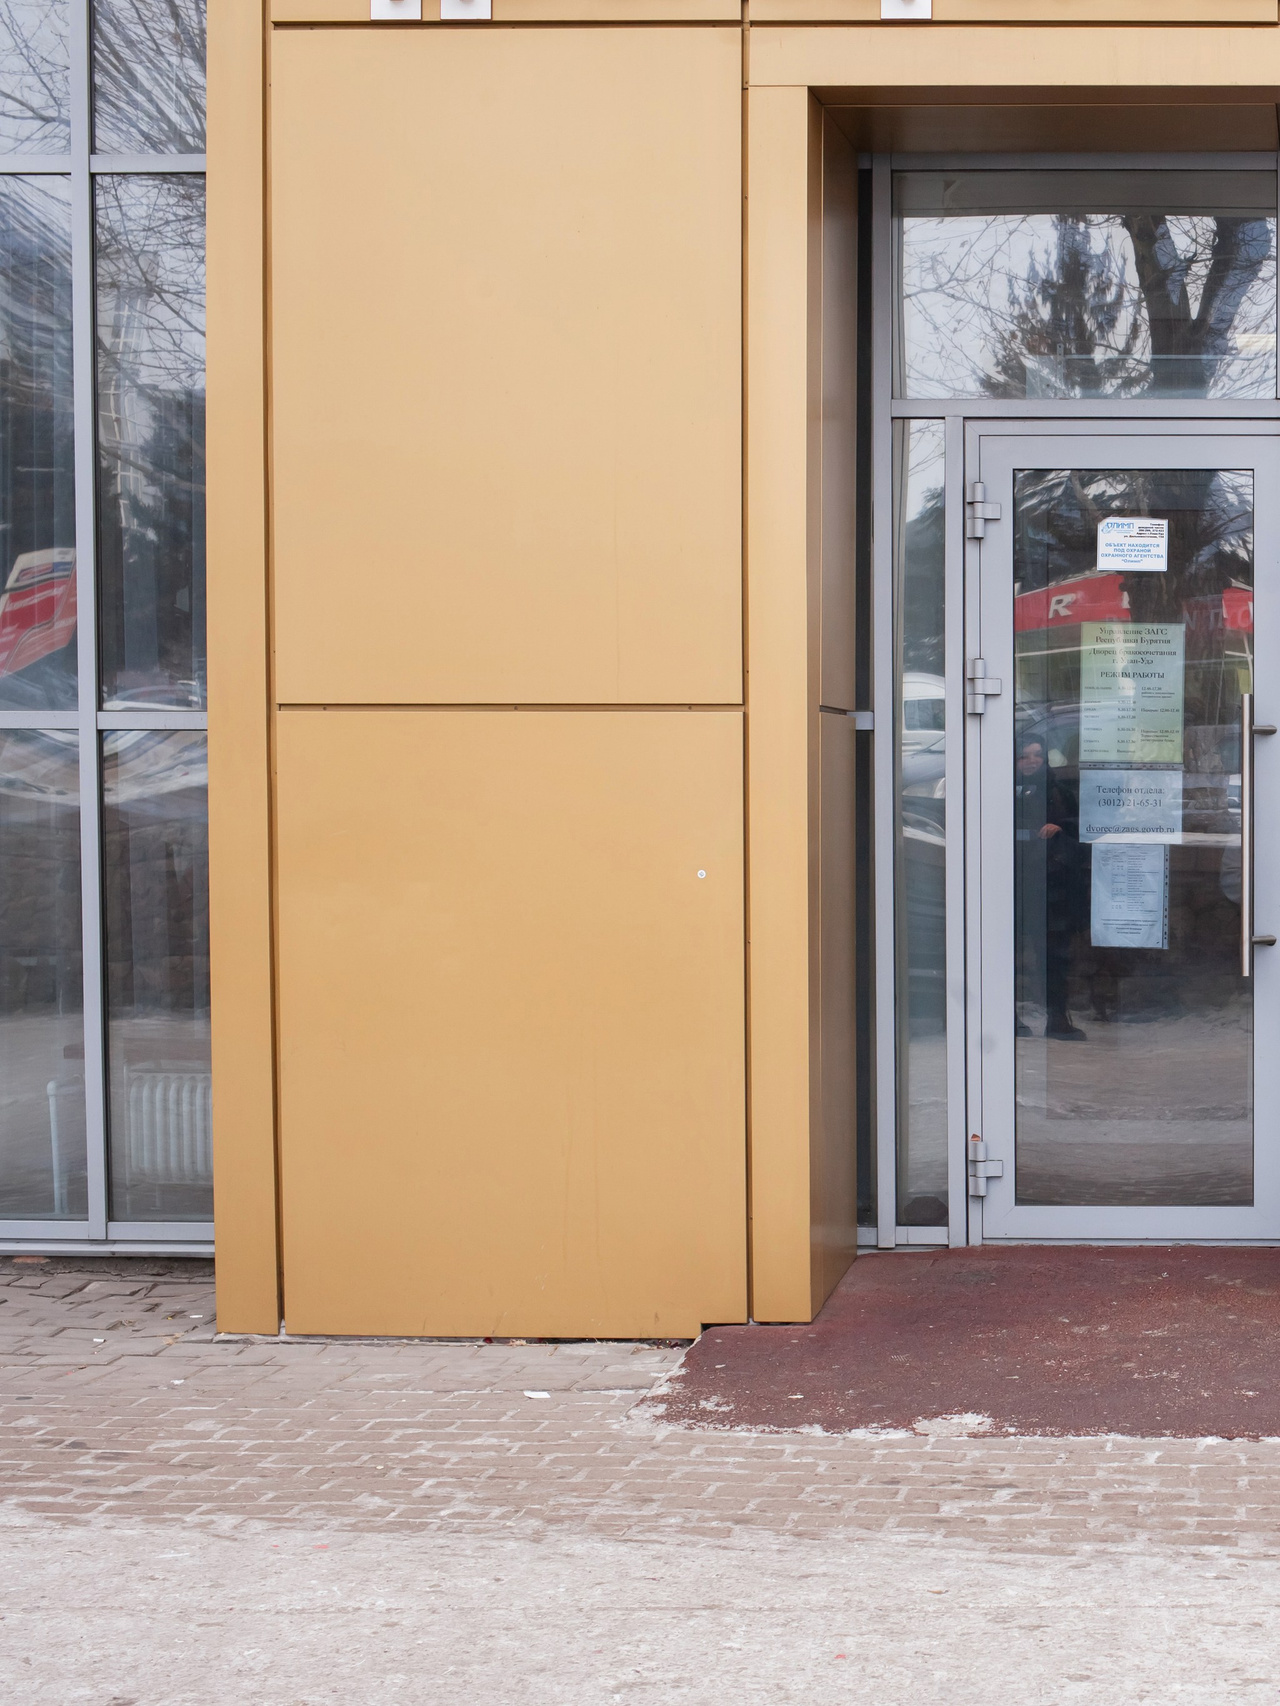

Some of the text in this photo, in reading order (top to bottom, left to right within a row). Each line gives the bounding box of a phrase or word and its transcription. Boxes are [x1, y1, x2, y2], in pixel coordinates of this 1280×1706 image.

[1088, 648, 1177, 656] Дворец бракосочетания
[1100, 671, 1165, 679] РЕЖИМ РАБОТЫ
[1096, 786, 1132, 795] Телефон
[1098, 799, 1162, 807] (3012) 21-65-31
[1086, 824, 1175, 833] dvorec@zags.govrb.ru
